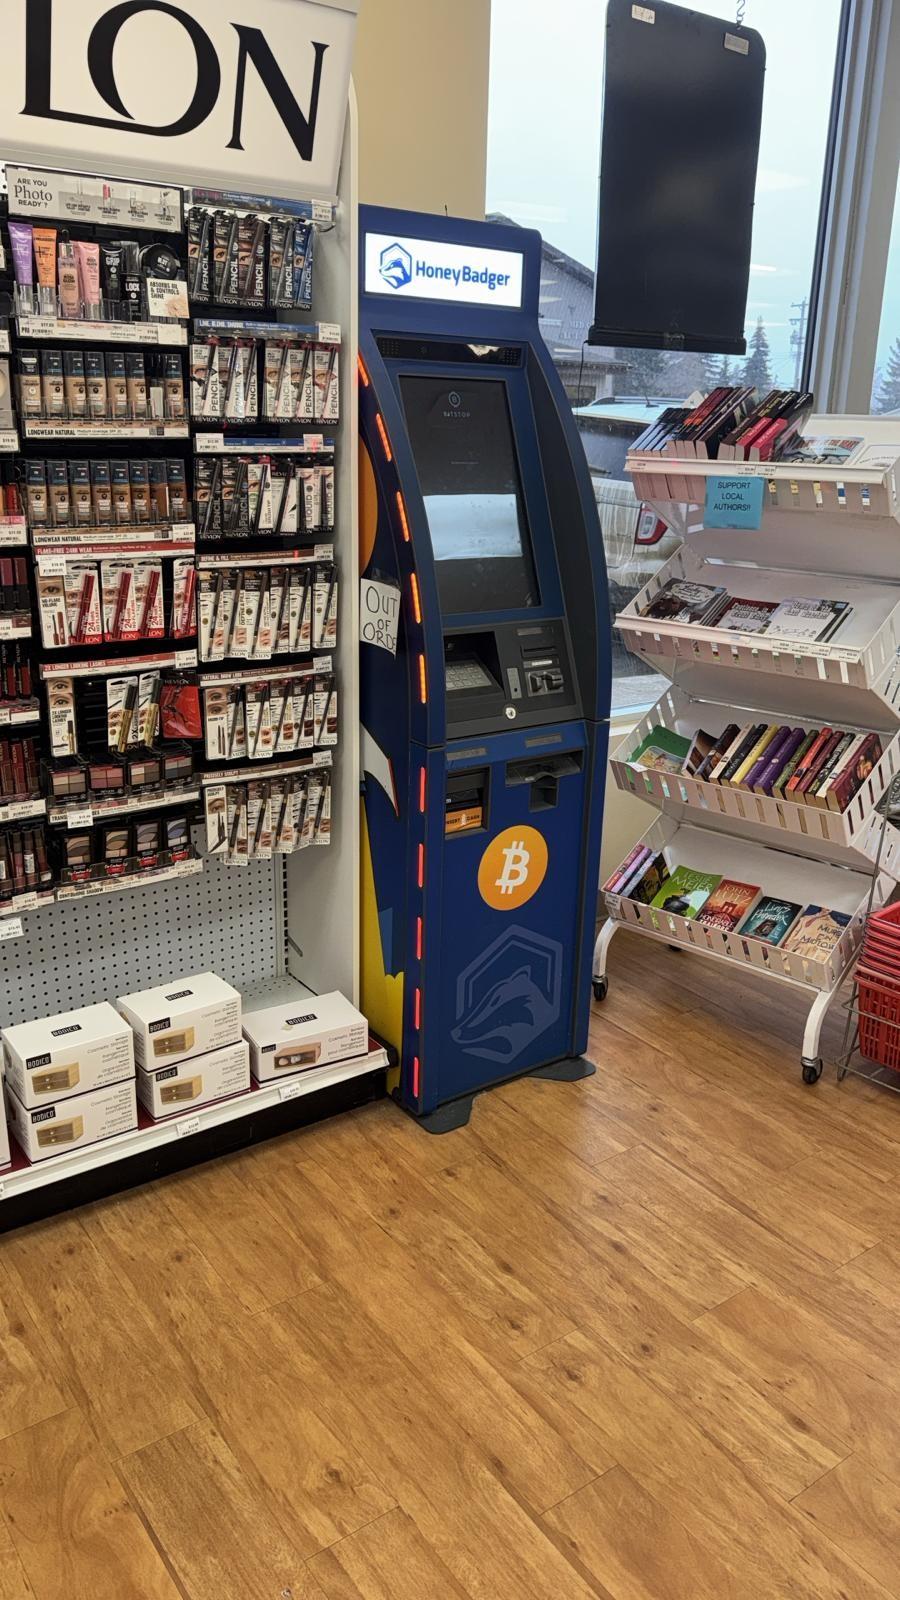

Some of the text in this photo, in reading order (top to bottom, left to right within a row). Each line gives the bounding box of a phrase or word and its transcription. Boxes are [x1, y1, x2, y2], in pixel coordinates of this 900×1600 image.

[14, 184, 53, 202] Photo
[18, 200, 41, 208] READY
[201, 256, 209, 291] PENCIL
[230, 258, 238, 294] PENCIL
[254, 262, 264, 296] PENCIL
[285, 262, 293, 298] PENCIL
[416, 261, 510, 290] HoneyBadger
[125, 282, 140, 292] LOCK
[304, 263, 312, 299] PENCIL
[211, 377, 219, 412] PENCIL
[717, 482, 750, 490] SUPPORT
[305, 494, 313, 526] LIQUID
[366, 586, 397, 618] OUT
[88, 618, 96, 632] 24
[377, 619, 391, 632] OF
[674, 876, 713, 892] MEIER
[723, 884, 751, 895] JOHN
[817, 924, 842, 937] MURD
[800, 935, 836, 949] MIDTOW
[53, 1026, 79, 1036] BODICO
[150, 1021, 170, 1032] BODICO
[28, 1056, 50, 1068] BODICO
[157, 1069, 177, 1080] BODICO
[32, 1111, 55, 1123] BODICO
